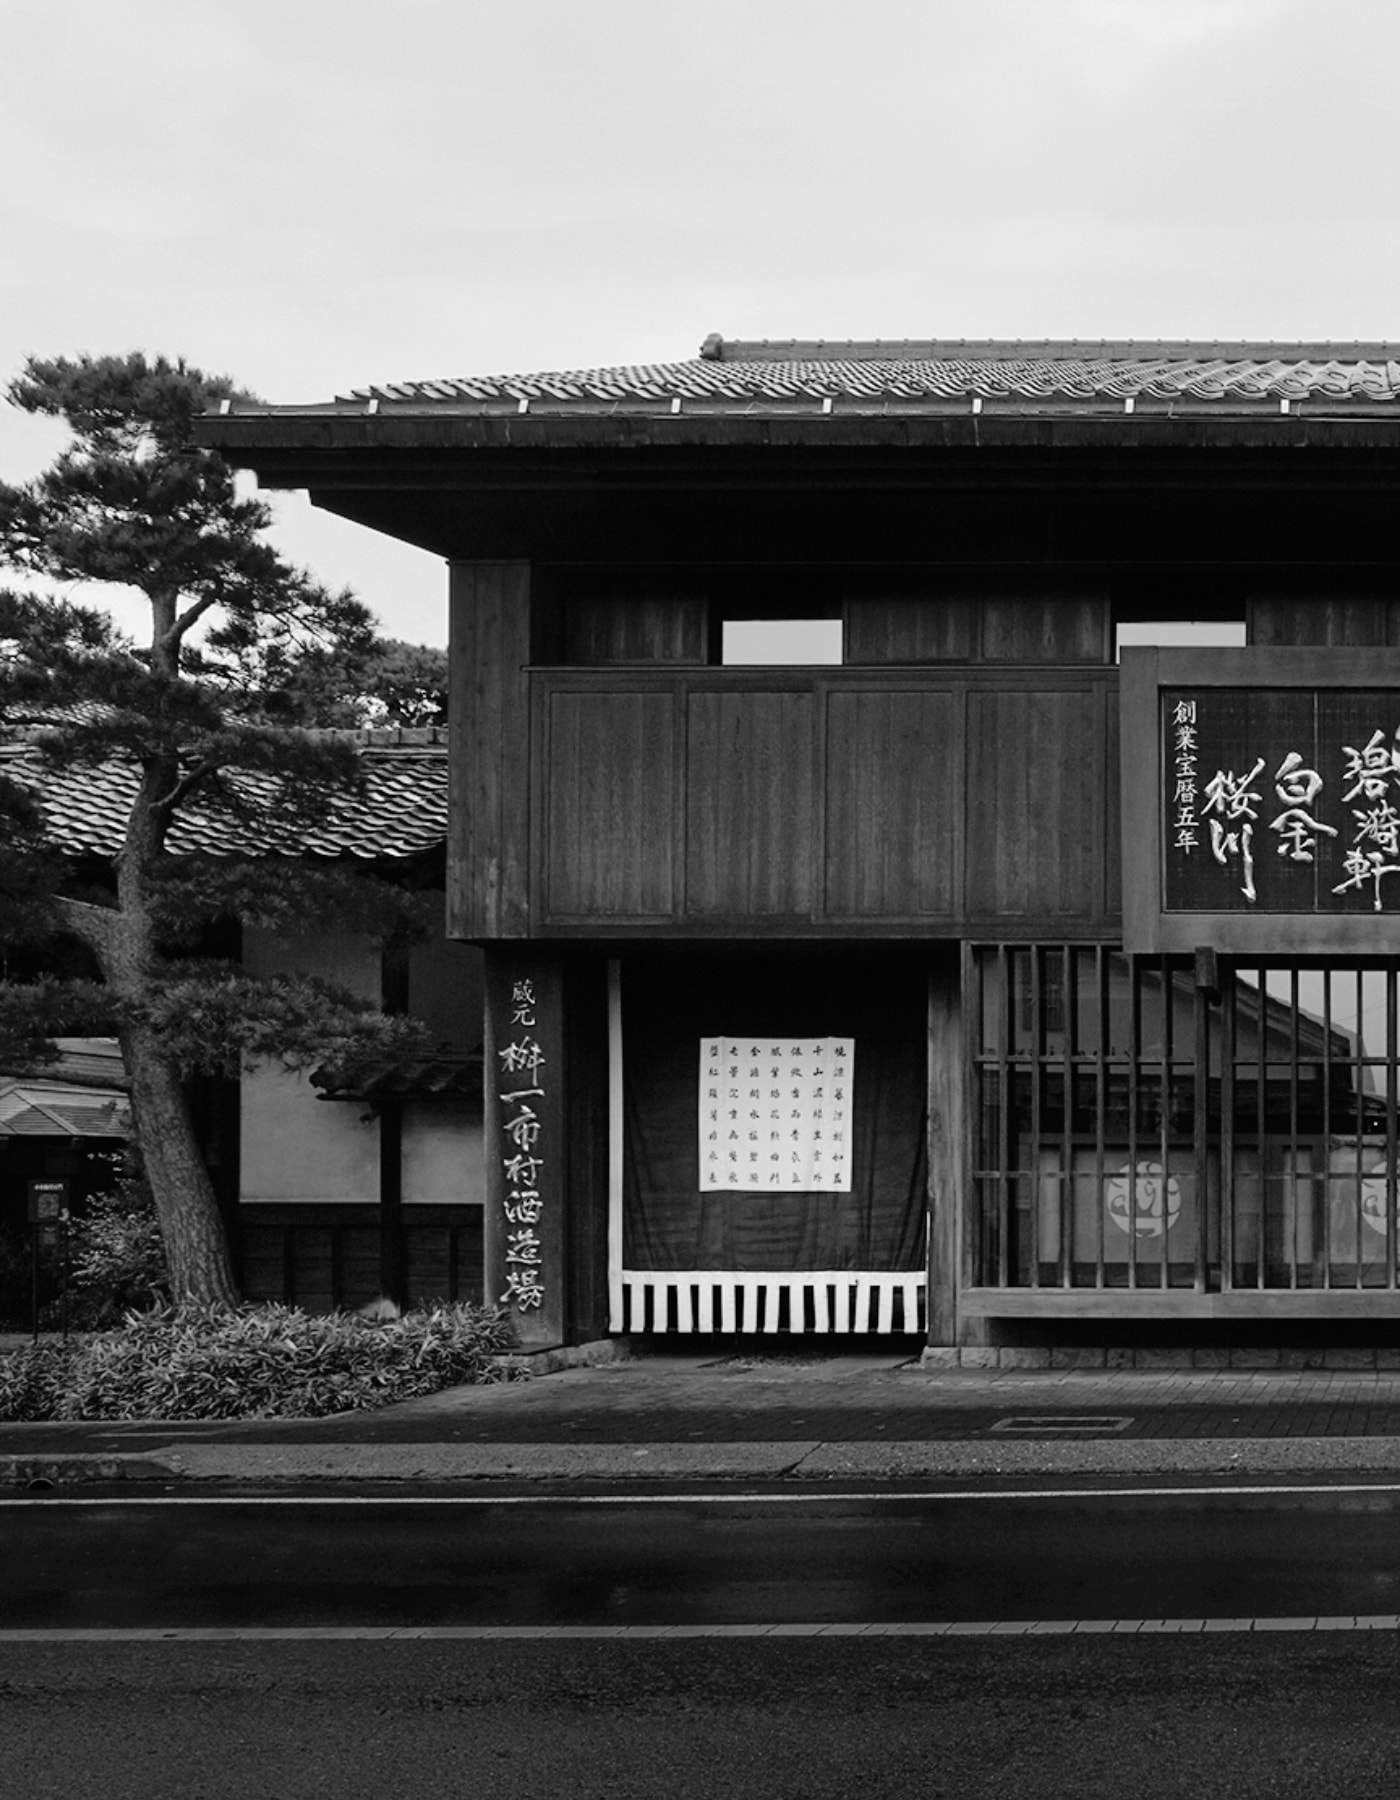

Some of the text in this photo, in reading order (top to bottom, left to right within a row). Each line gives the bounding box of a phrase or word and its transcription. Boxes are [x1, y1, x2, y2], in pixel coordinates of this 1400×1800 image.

[1172, 700, 1199, 855] 創業宝暦五年
[1200, 757, 1266, 903] 桜川
[1269, 752, 1338, 862] 白金
